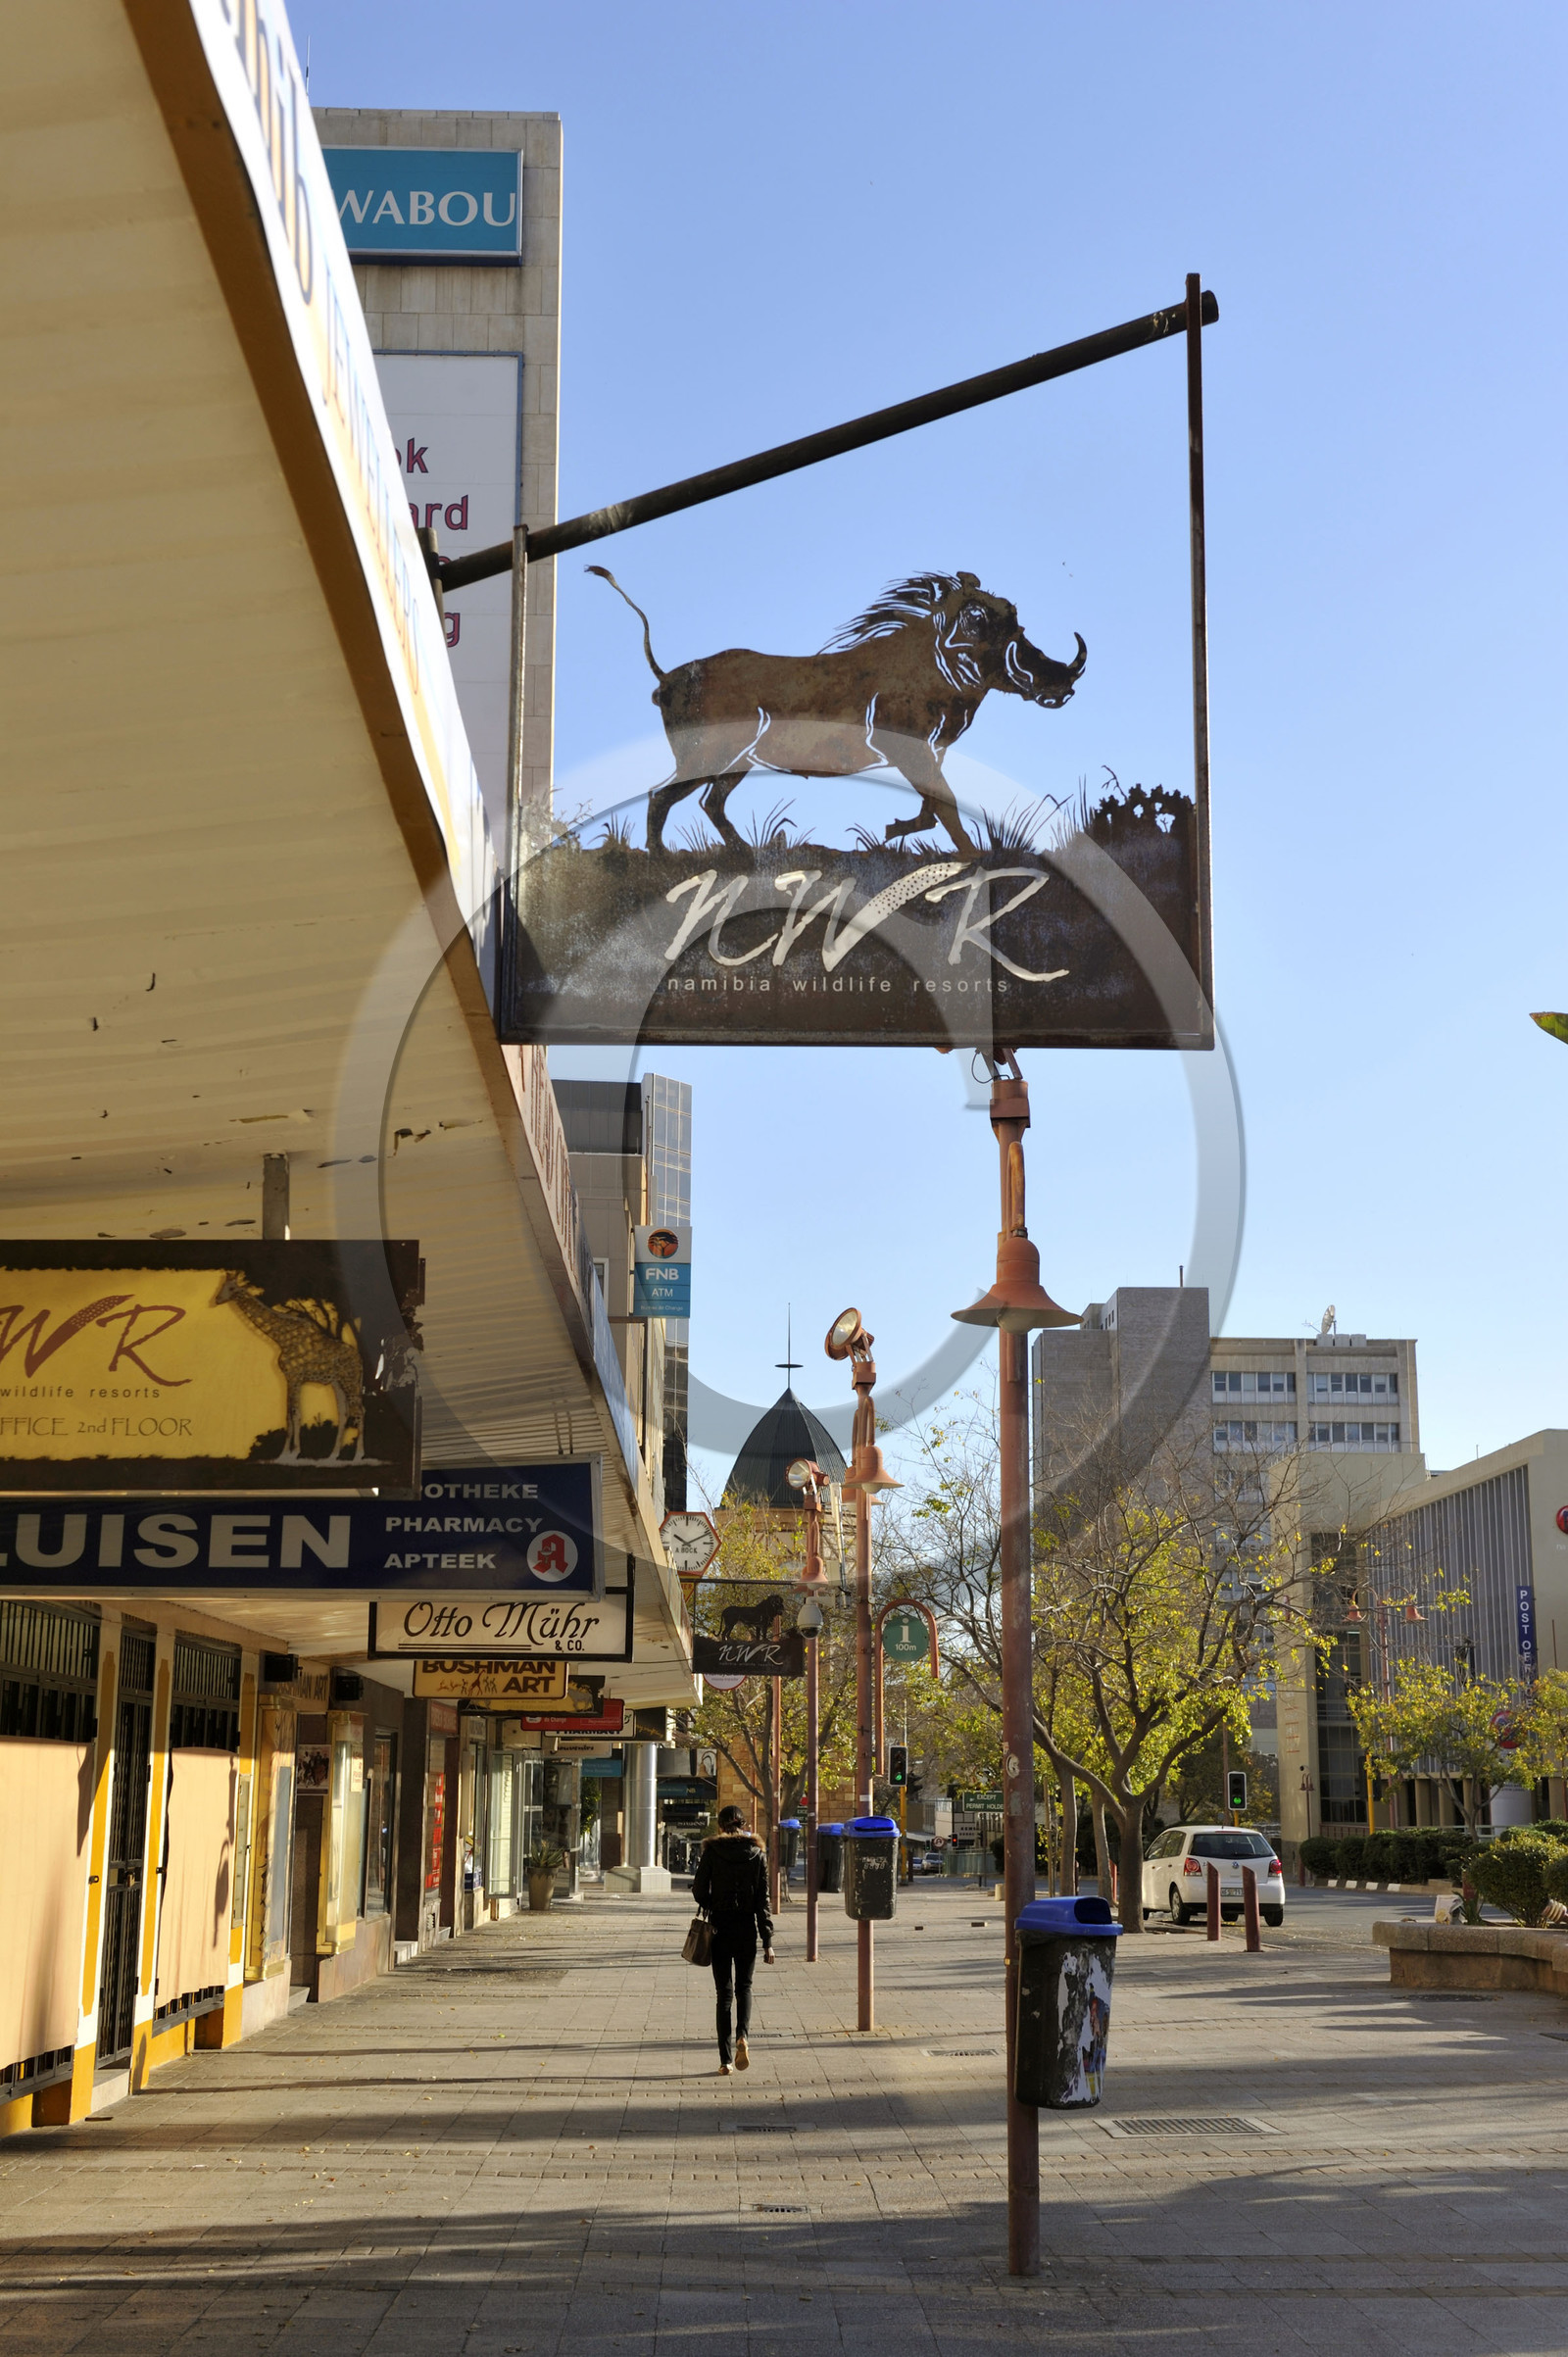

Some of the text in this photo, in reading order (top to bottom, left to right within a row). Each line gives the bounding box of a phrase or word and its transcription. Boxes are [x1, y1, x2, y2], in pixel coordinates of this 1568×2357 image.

[664, 861, 1070, 982] NWR
[667, 975, 1008, 993] namibia wildlife resorts
[645, 1267, 679, 1281] FNB
[651, 1288, 673, 1298] ATM
[89, 1388, 161, 1399] resorts
[76, 1417, 107, 1434] 2nd
[112, 1417, 193, 1437] FLOOR
[422, 1483, 539, 1499] OTHEKE
[385, 1517, 543, 1533] PHARMACY
[0, 1513, 351, 1569] UISEN
[383, 1553, 497, 1570] APTEEK
[1520, 1590, 1530, 1635] POST
[403, 1601, 600, 1645] Otto Mühr
[555, 1640, 564, 1652] &
[502, 1676, 556, 1694] ART
